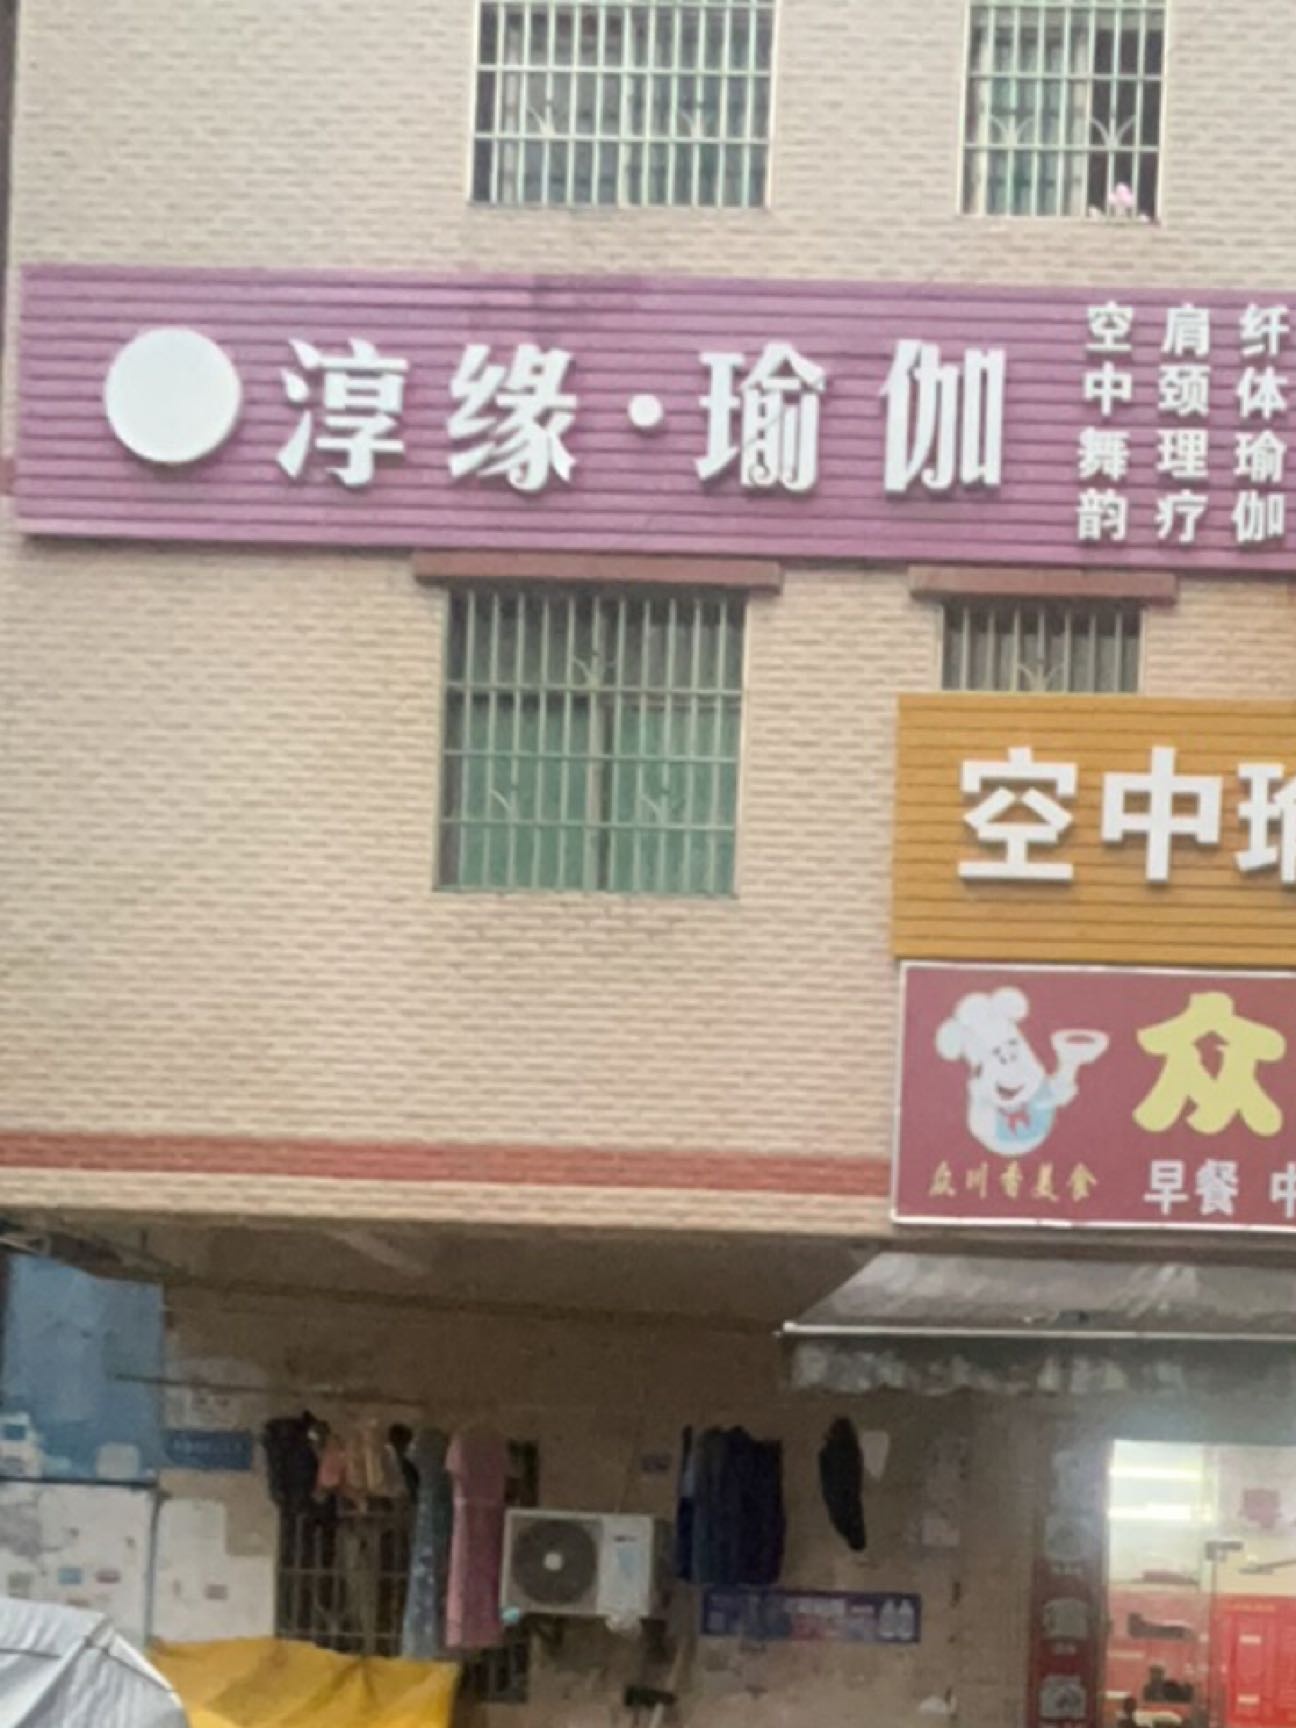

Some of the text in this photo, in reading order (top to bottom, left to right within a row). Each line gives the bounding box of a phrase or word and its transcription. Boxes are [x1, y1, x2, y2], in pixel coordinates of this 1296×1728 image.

[1075, 299, 1136, 542] 空中舞韵
[1154, 301, 1213, 544] 肩颈理疗
[1230, 301, 1291, 544] 纤体瑜伽
[1144, 1159, 1239, 1216] 早餐
